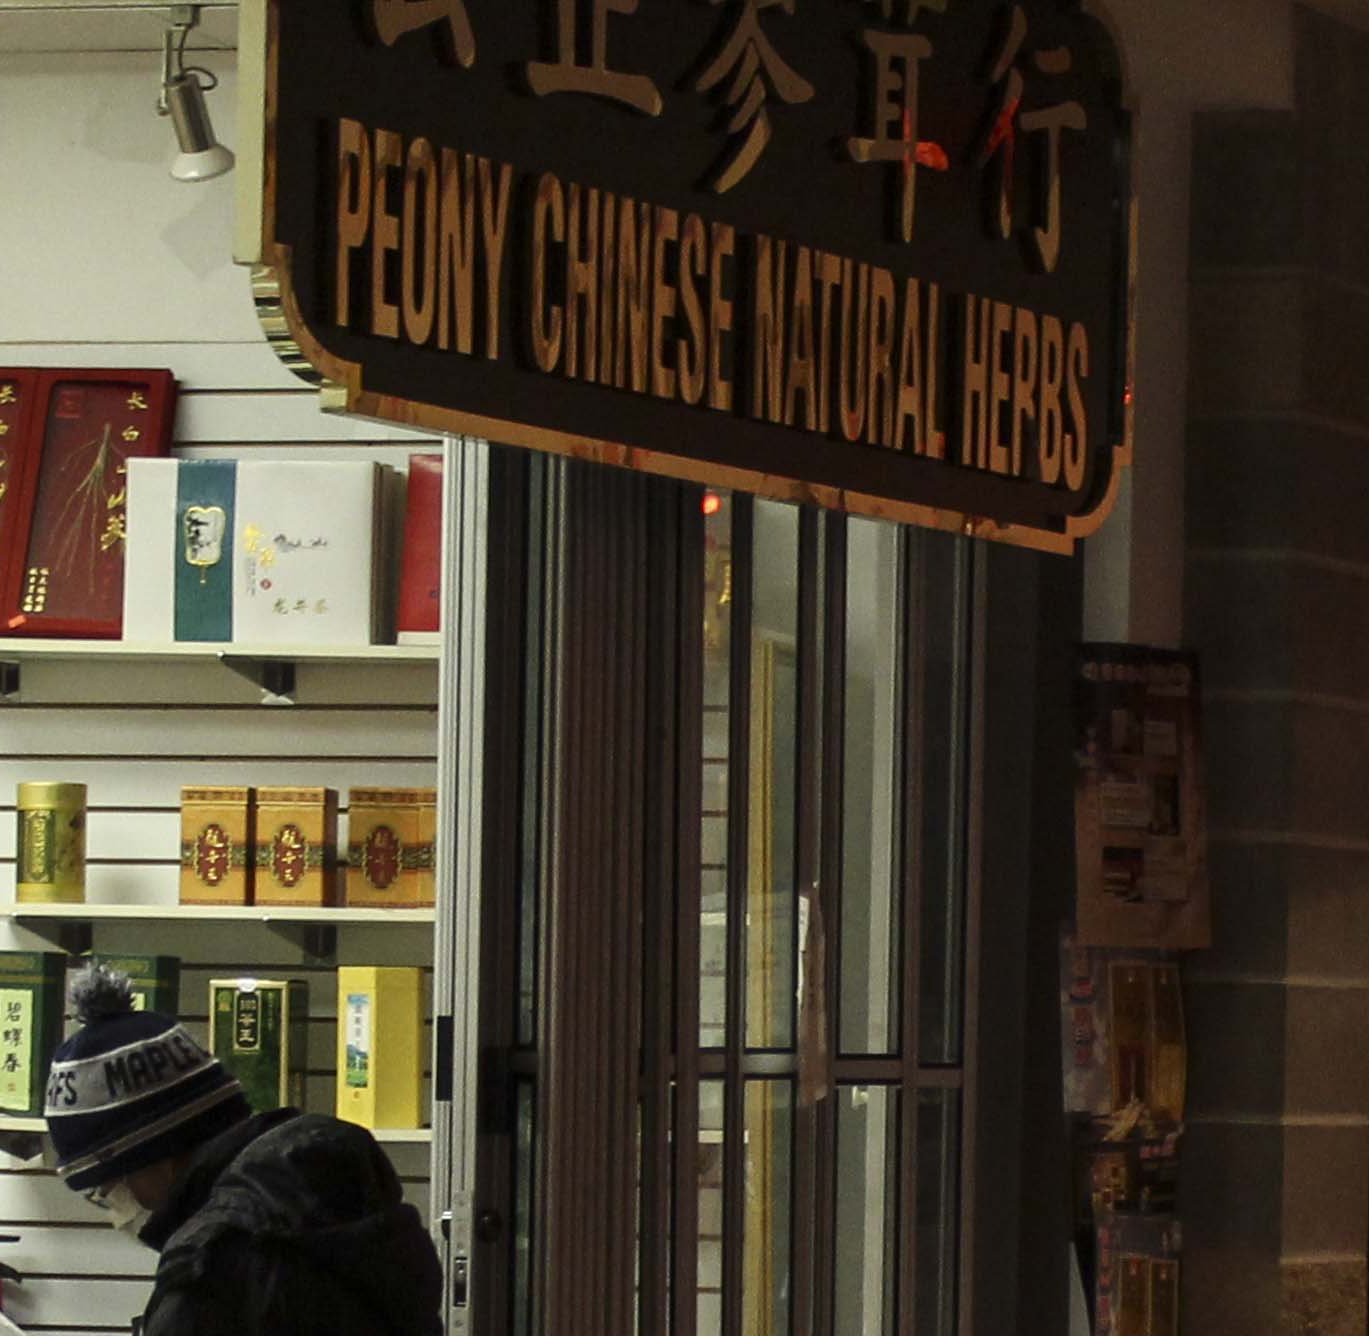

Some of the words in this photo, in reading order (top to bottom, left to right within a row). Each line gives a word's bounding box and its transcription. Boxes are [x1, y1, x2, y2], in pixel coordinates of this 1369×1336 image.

[335, 116, 513, 361] PEONY
[530, 171, 735, 413] CHINESE
[750, 233, 946, 459] NATURAL
[961, 291, 1089, 492] HERBS
